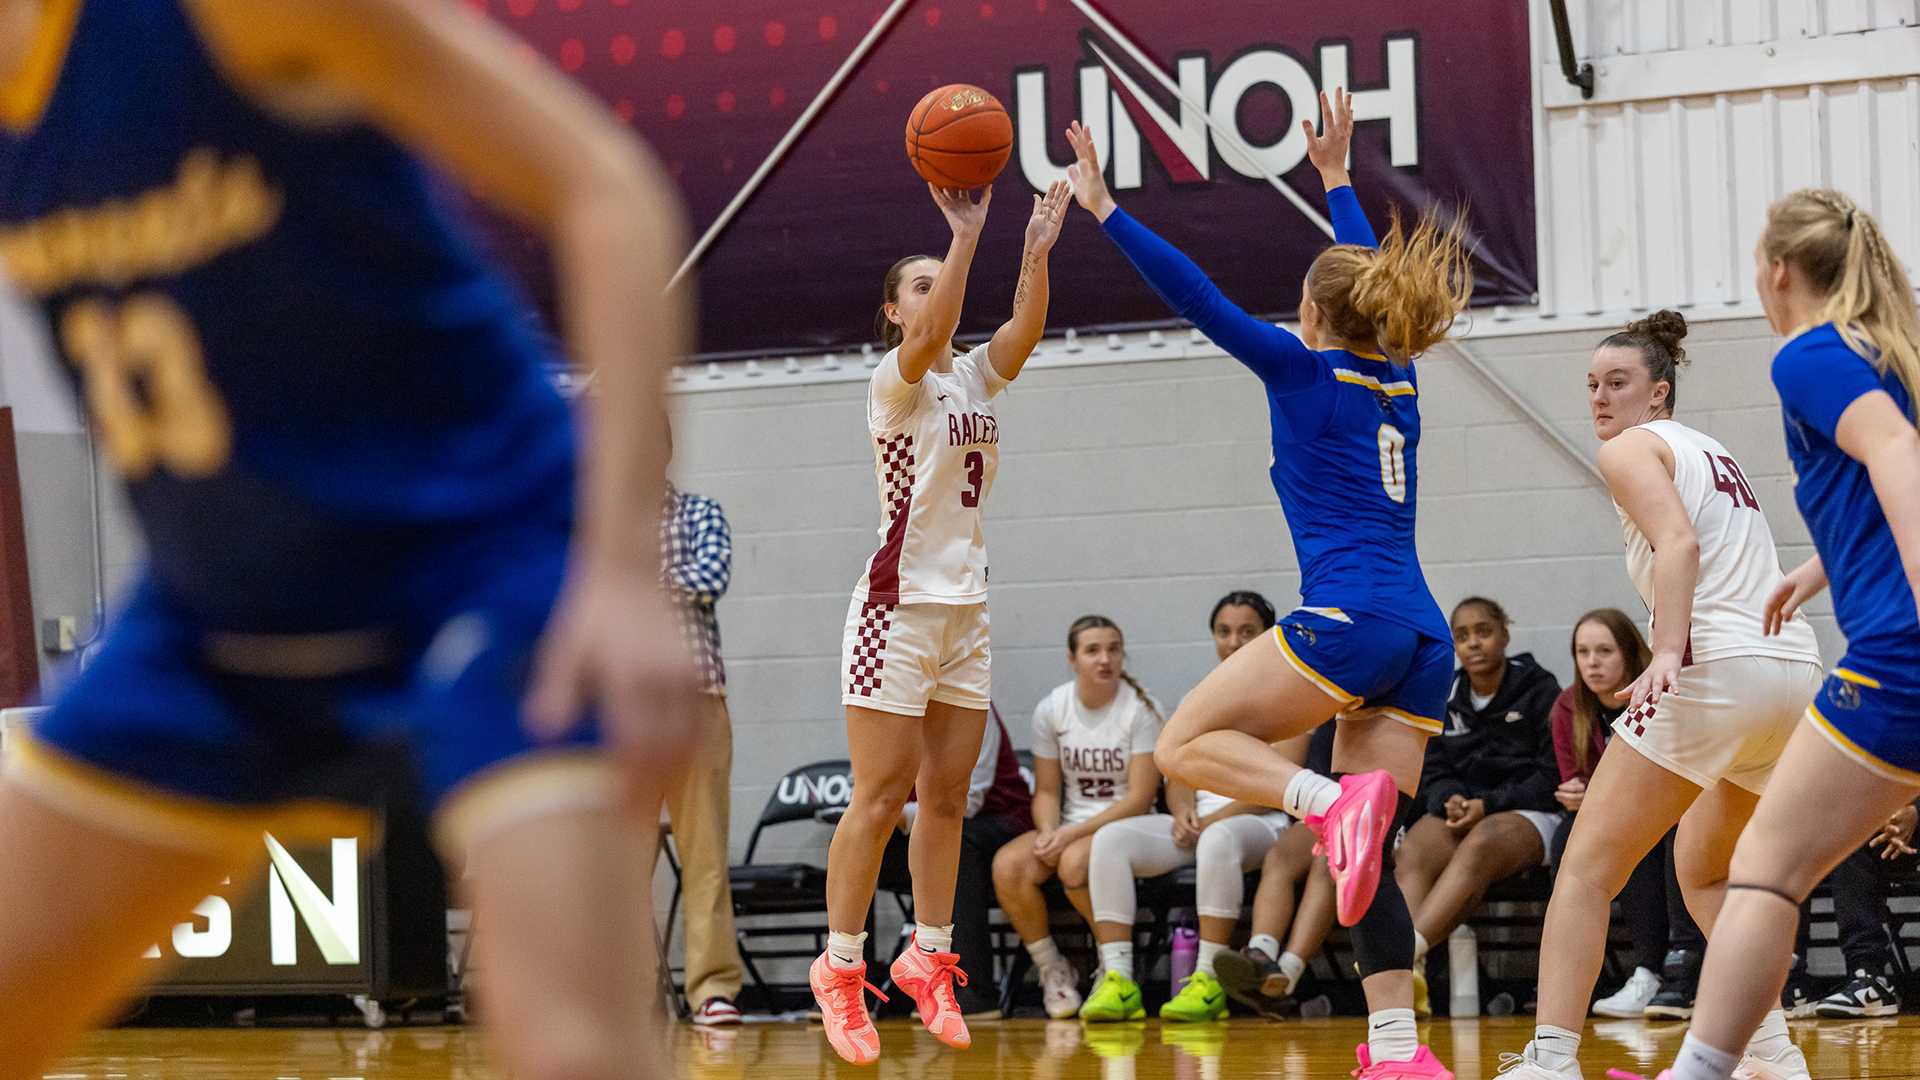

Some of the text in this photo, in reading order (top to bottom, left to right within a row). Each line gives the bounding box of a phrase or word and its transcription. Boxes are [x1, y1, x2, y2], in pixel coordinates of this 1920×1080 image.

[1016, 38, 1419, 194] UNOH
[961, 451, 984, 507] 3
[1377, 423, 1406, 503] 0
[1702, 449, 1761, 512] 40
[1063, 746, 1125, 773] RACERS
[1077, 777, 1115, 798] 22
[263, 829, 360, 966] N
